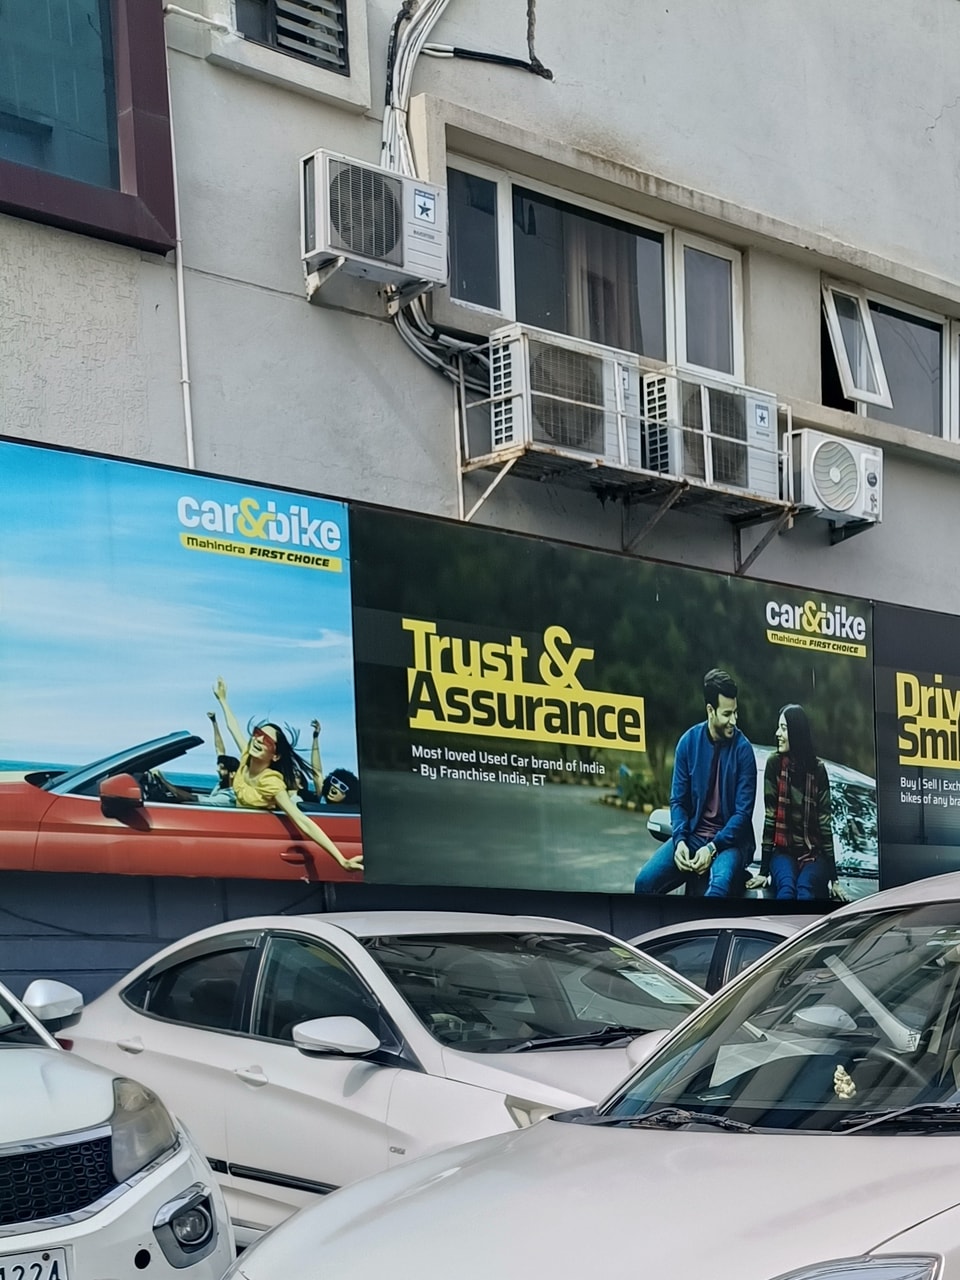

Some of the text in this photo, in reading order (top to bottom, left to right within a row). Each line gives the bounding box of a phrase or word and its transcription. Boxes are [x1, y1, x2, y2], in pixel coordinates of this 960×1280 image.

[177, 496, 341, 551] car&bike
[250, 547, 285, 560] FIRST
[287, 553, 330, 567] CHOICE
[766, 600, 866, 640] car&bike
[402, 618, 594, 690] Trust &
[809, 640, 831, 649] FIRST
[832, 643, 859, 653] CHOICE
[408, 670, 641, 742] Assurance
[411, 745, 606, 774] Most loved Used Car brand of India
[420, 764, 437, 780] By
[440, 766, 496, 782] Franchise
[499, 771, 529, 786] India,
[532, 774, 546, 786] ET
[900, 777, 916, 790] Buy
[922, 779, 937, 790] Sell
[900, 792, 922, 804] bikes
[923, 794, 931, 804] of
[933, 796, 948, 807] any
